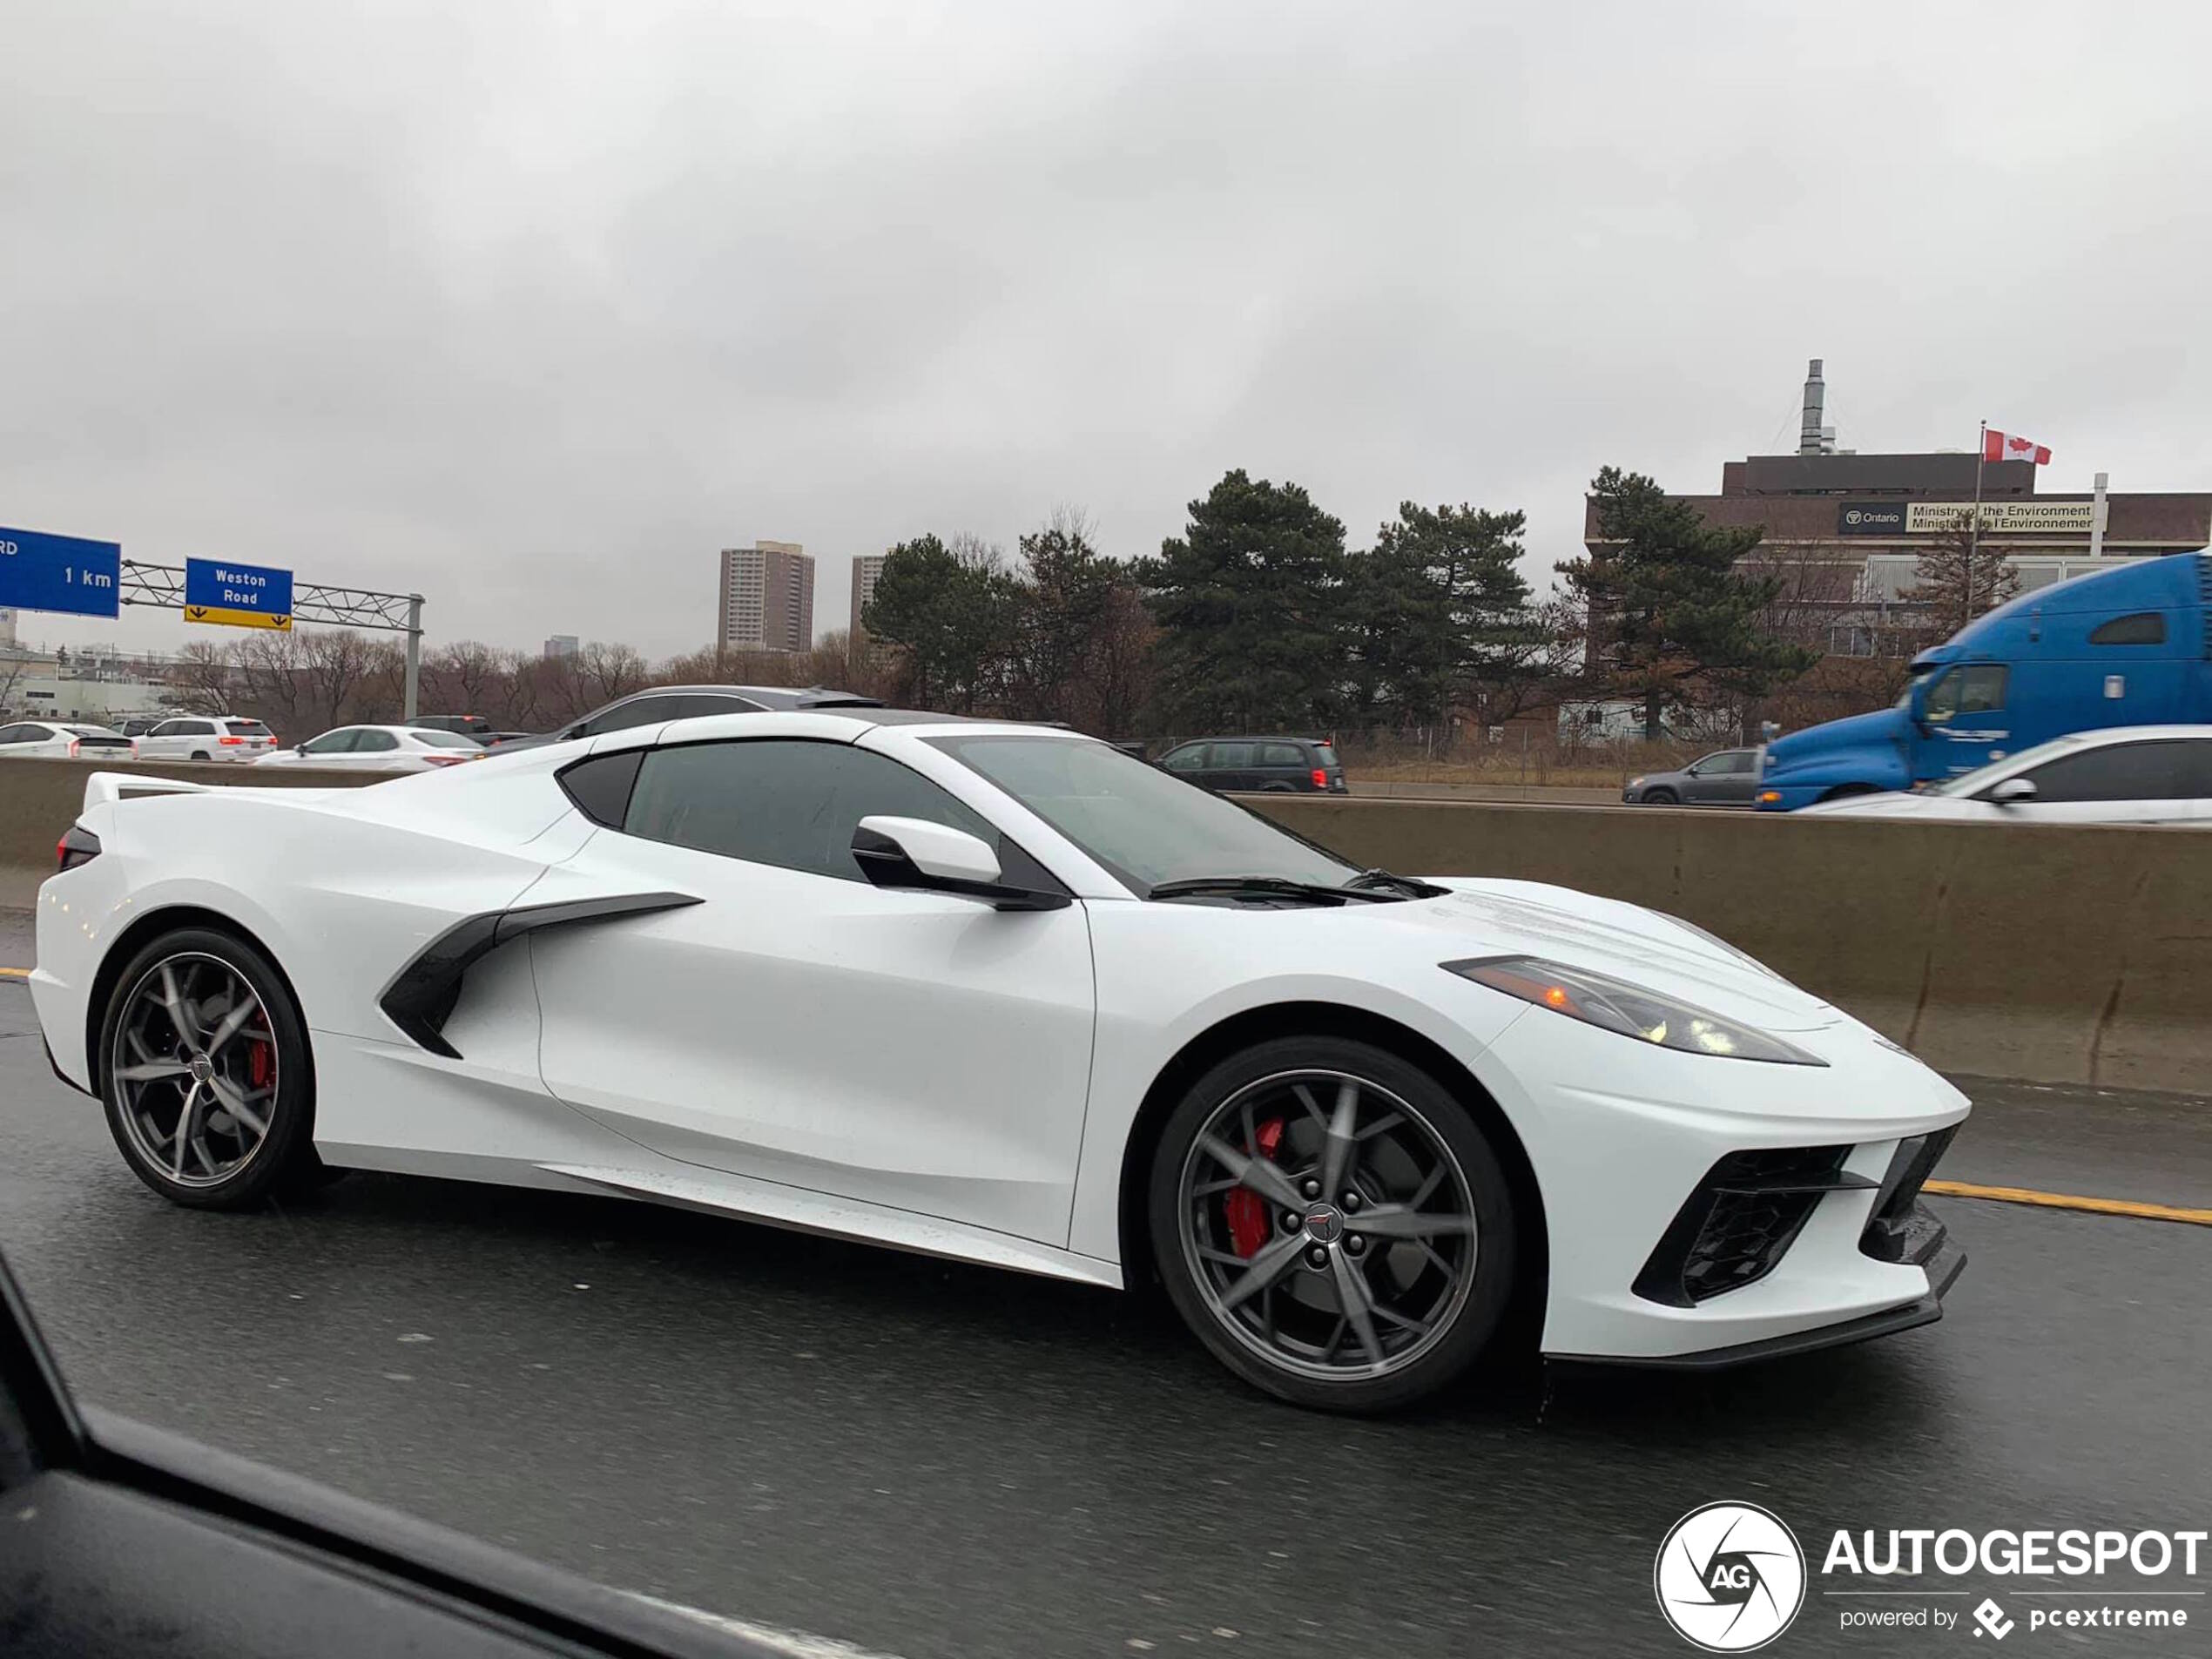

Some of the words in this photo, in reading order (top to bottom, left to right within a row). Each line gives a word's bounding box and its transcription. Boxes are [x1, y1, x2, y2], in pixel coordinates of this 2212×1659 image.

[1864, 512, 1899, 523] Ontario
[1913, 506, 1963, 518] Ministry
[1967, 506, 1980, 516] o
[1983, 505, 2003, 516] the
[2007, 506, 2090, 516] Environment
[64, 567, 72, 583] 1
[83, 570, 111, 587] km
[216, 569, 266, 587] Weston
[224, 589, 258, 604] Road
